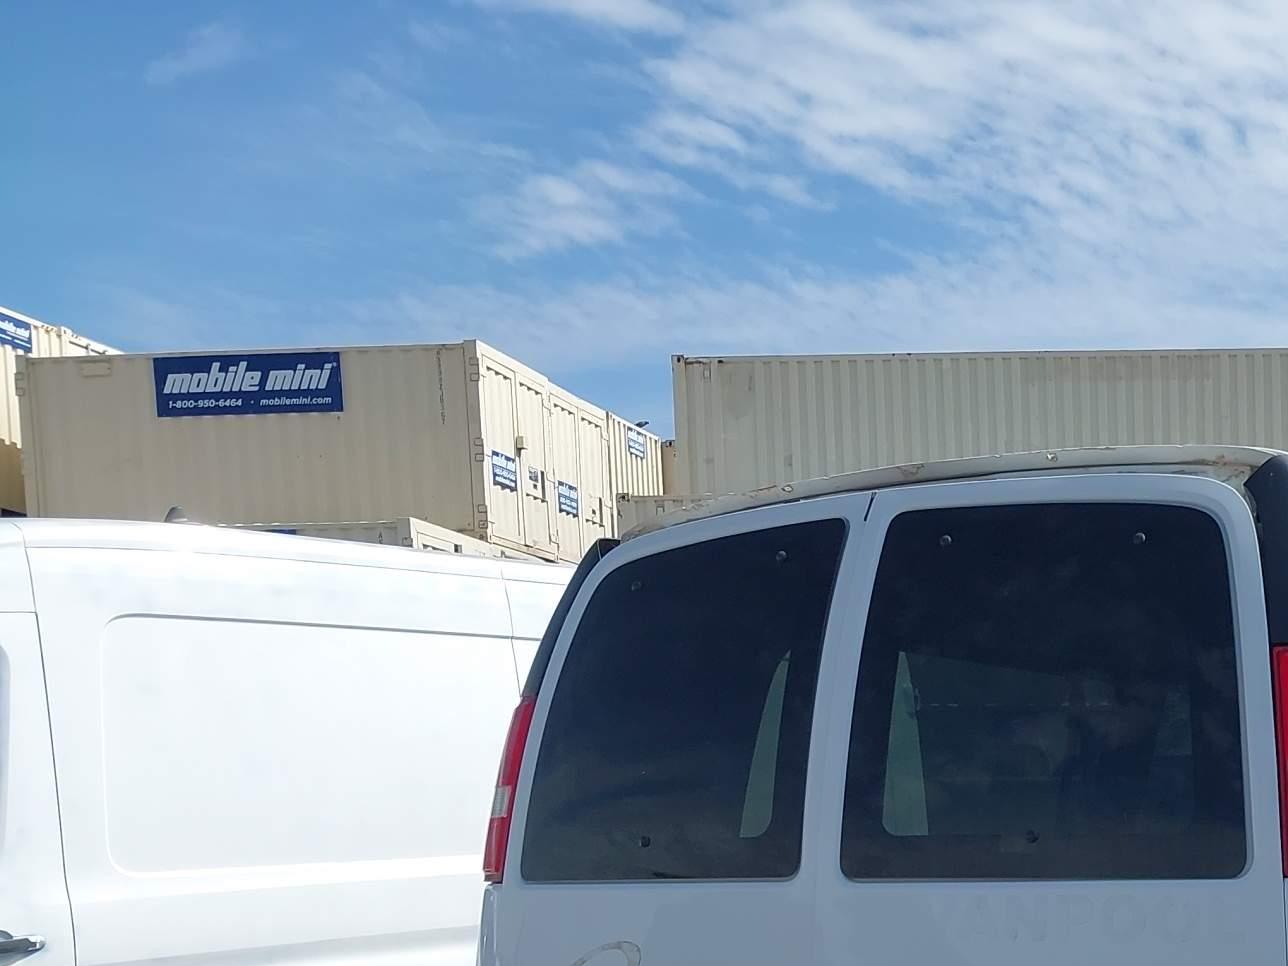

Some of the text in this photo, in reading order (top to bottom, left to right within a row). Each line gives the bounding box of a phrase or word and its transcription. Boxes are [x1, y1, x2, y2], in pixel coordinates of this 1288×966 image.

[162, 360, 333, 394] mobile mini
[168, 396, 332, 409] 1-800-950-6464 mobilemini.com
